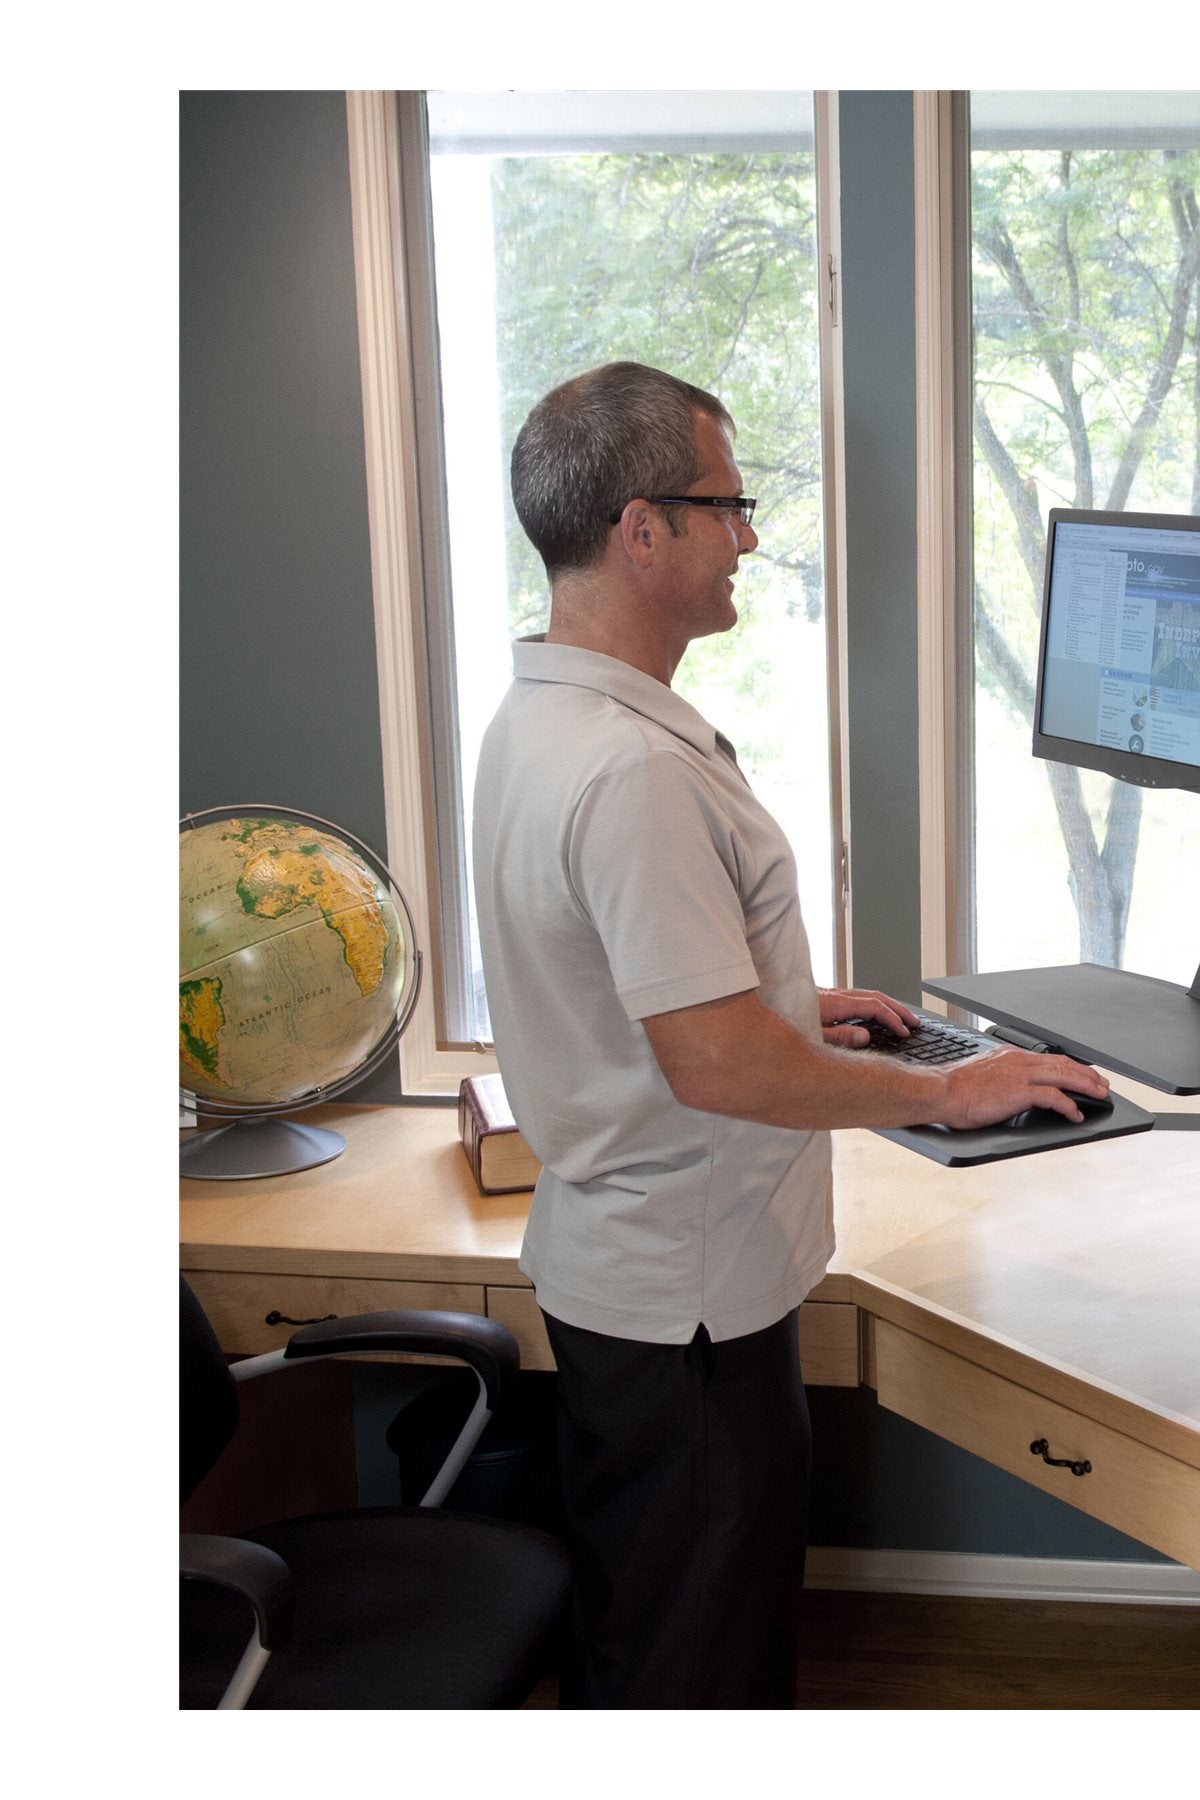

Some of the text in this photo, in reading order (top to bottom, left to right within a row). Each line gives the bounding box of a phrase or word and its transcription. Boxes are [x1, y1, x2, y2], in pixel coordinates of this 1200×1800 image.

[189, 884, 223, 904] OCEAN
[239, 986, 332, 1027] ATLANTIC OCEAN
